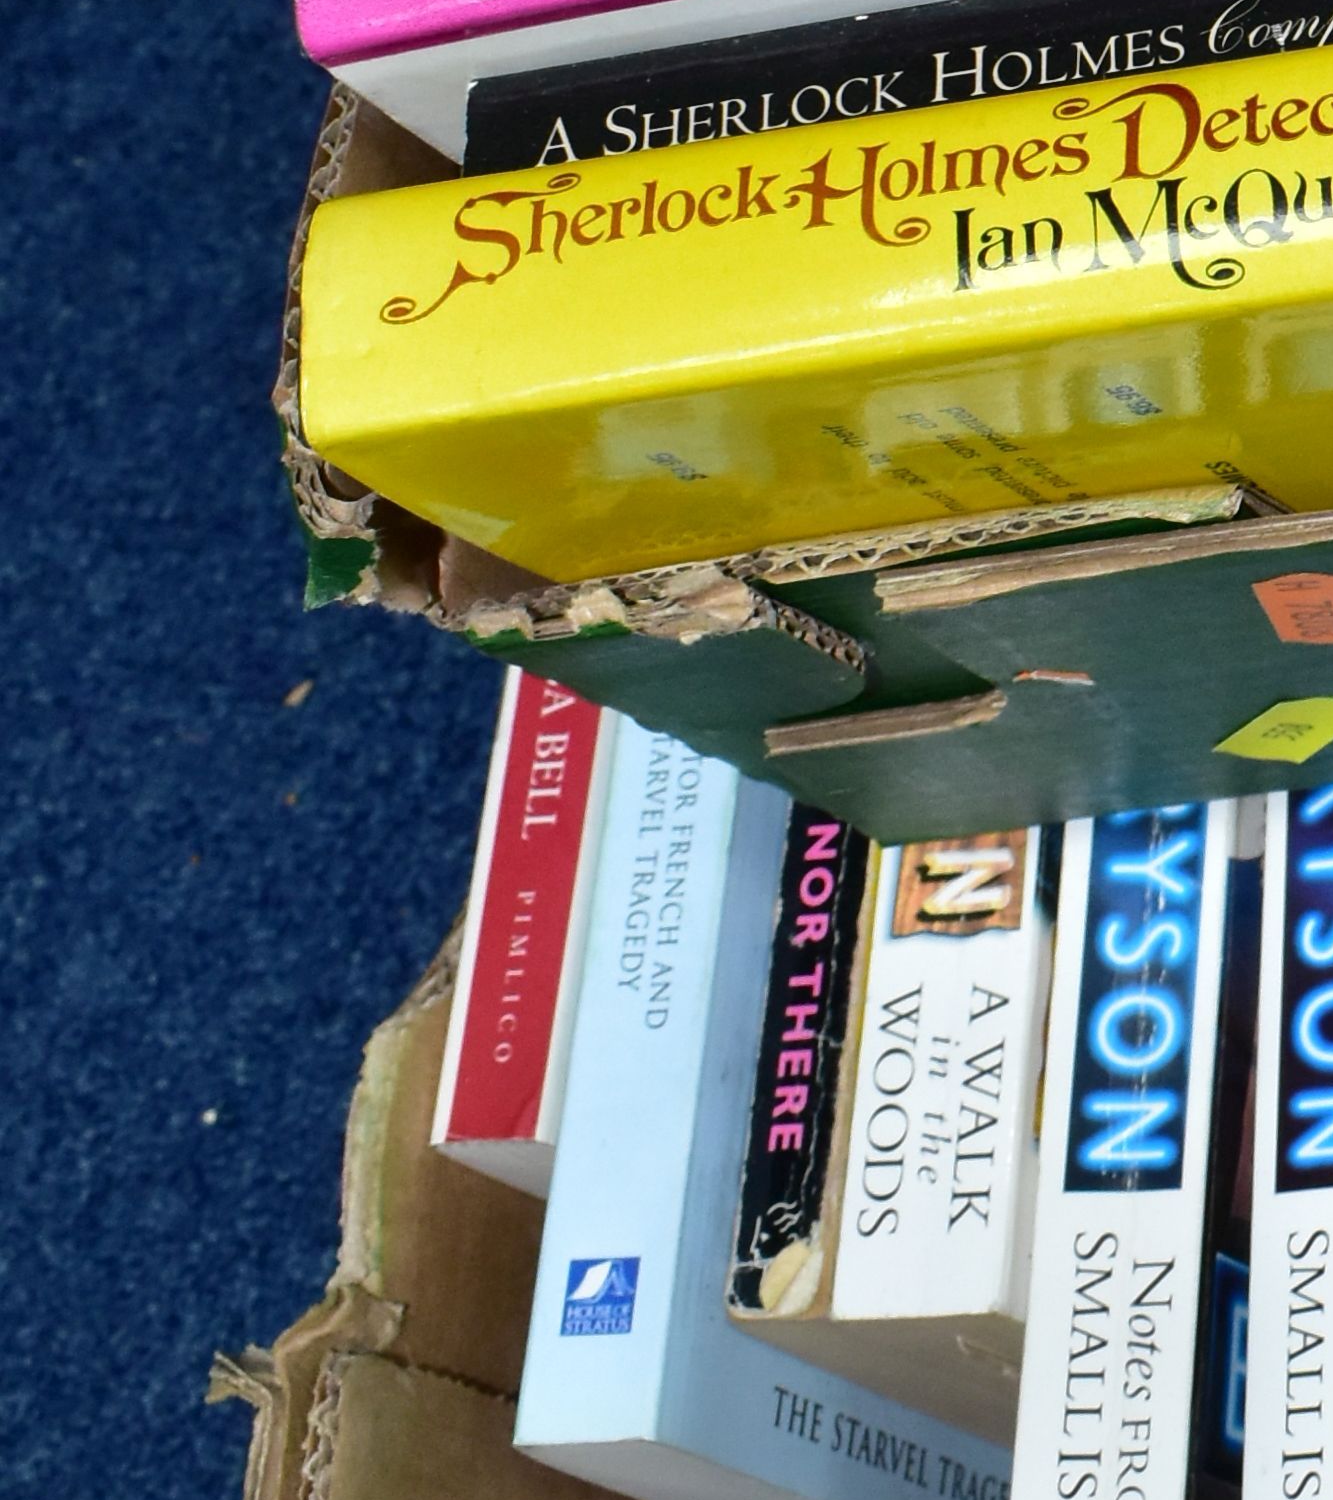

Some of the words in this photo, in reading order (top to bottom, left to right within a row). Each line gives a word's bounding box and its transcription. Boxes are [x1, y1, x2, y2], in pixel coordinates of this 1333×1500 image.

[534, 116, 578, 170] A
[601, 70, 904, 158] SHERLOCK
[931, 20, 1188, 105] HOLMES
[782, 128, 1090, 250] Holmes
[952, 206, 1065, 294] Ian
[519, 738, 570, 841] BELL
[614, 852, 658, 994] TRAGEDY
[660, 822, 700, 950] FRENCH
[790, 822, 842, 944] NOR
[490, 888, 538, 1065] PIMLICO
[644, 962, 674, 1033] AND
[968, 984, 1011, 1022] A
[765, 964, 823, 1153] THERE
[853, 981, 926, 1238] WOODS
[924, 1033, 947, 1079] in
[914, 1116, 951, 1185] the
[947, 1040, 1007, 1234] WALK
[1283, 1227, 1331, 1436] SMALL
[772, 1384, 823, 1445] THE
[830, 1410, 929, 1490] STARVEL
